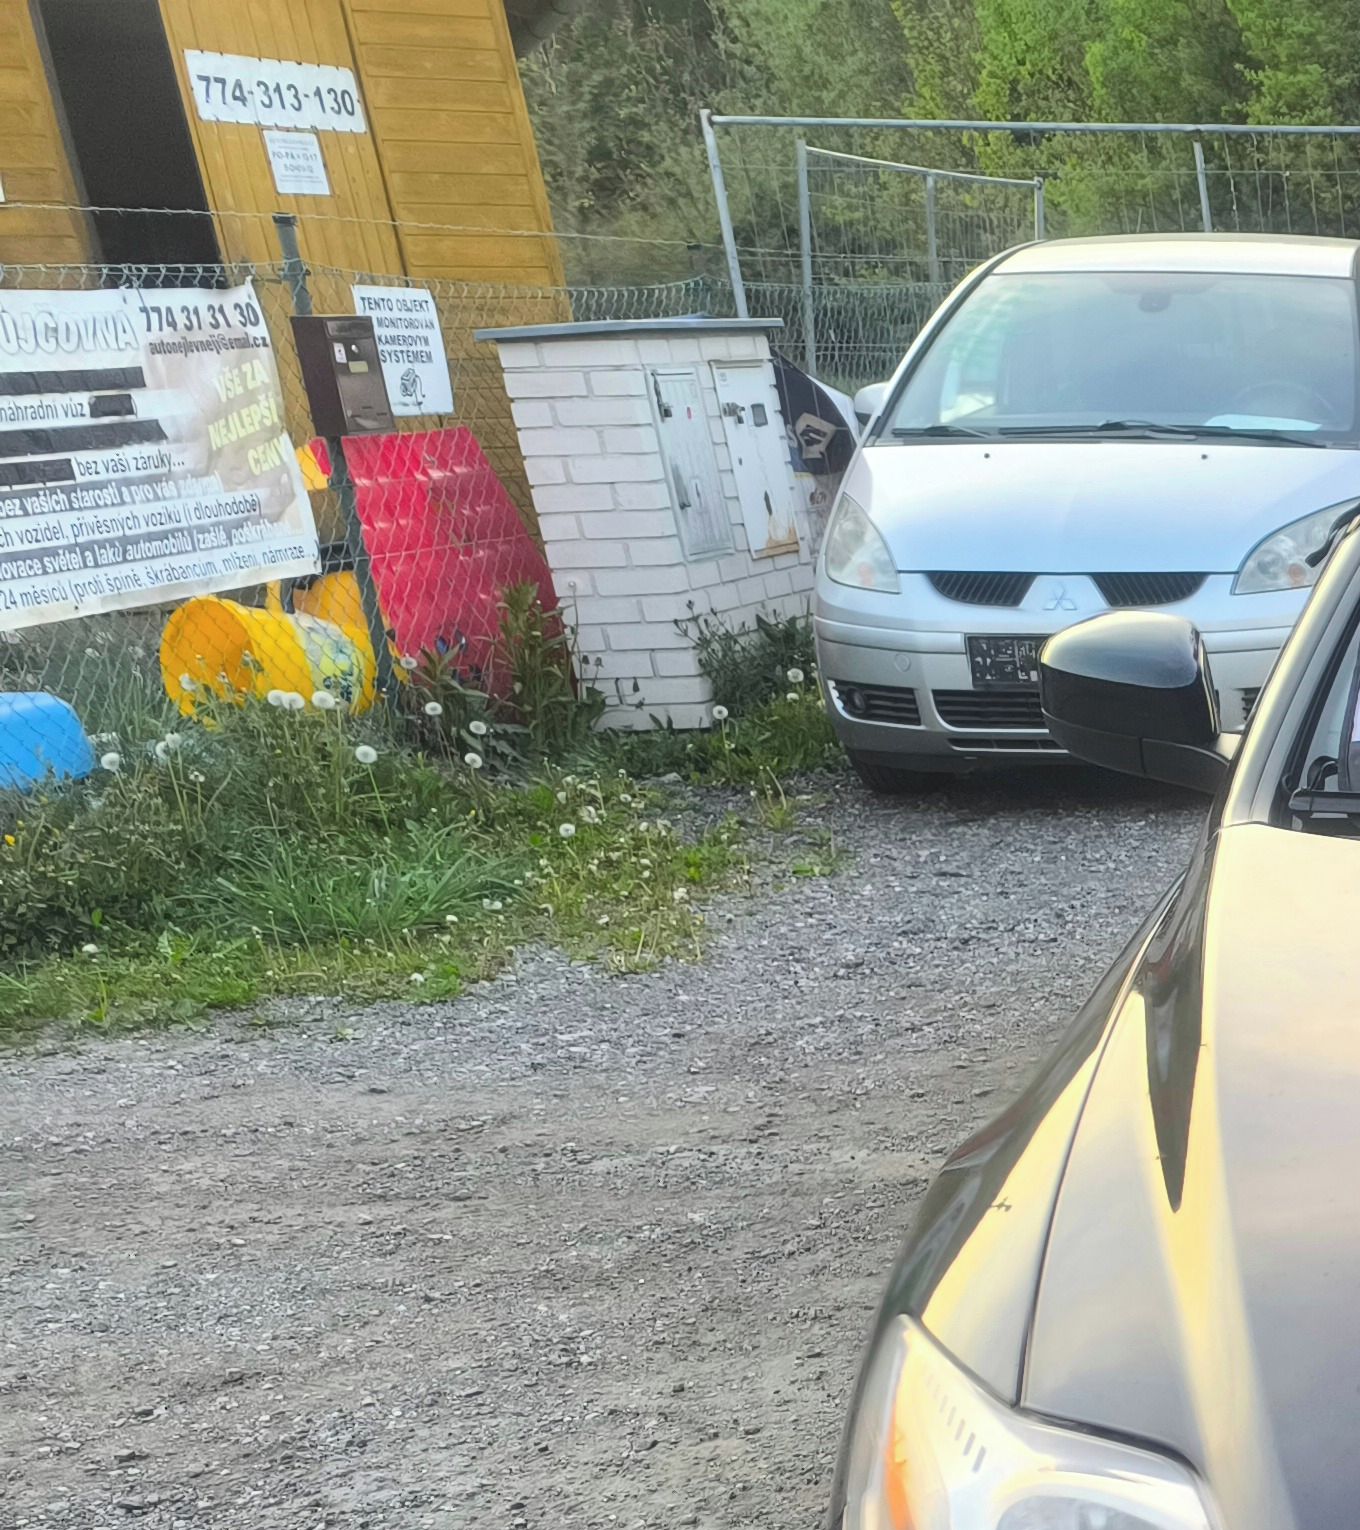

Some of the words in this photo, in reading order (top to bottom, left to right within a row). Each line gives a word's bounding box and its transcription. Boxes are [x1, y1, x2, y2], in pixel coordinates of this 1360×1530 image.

[197, 75, 355, 117] 774-313-130
[139, 306, 178, 332] 774
[180, 305, 202, 331] 31
[207, 304, 231, 329] 31
[233, 302, 260, 327] 30
[360, 296, 393, 313] TENTO
[396, 299, 430, 313] OBJEKT
[214, 366, 243, 403] VŠE
[241, 359, 270, 390] ZA
[74, 454, 100, 476] bez
[247, 434, 288, 476] CENY
[85, 554, 94, 567] a
